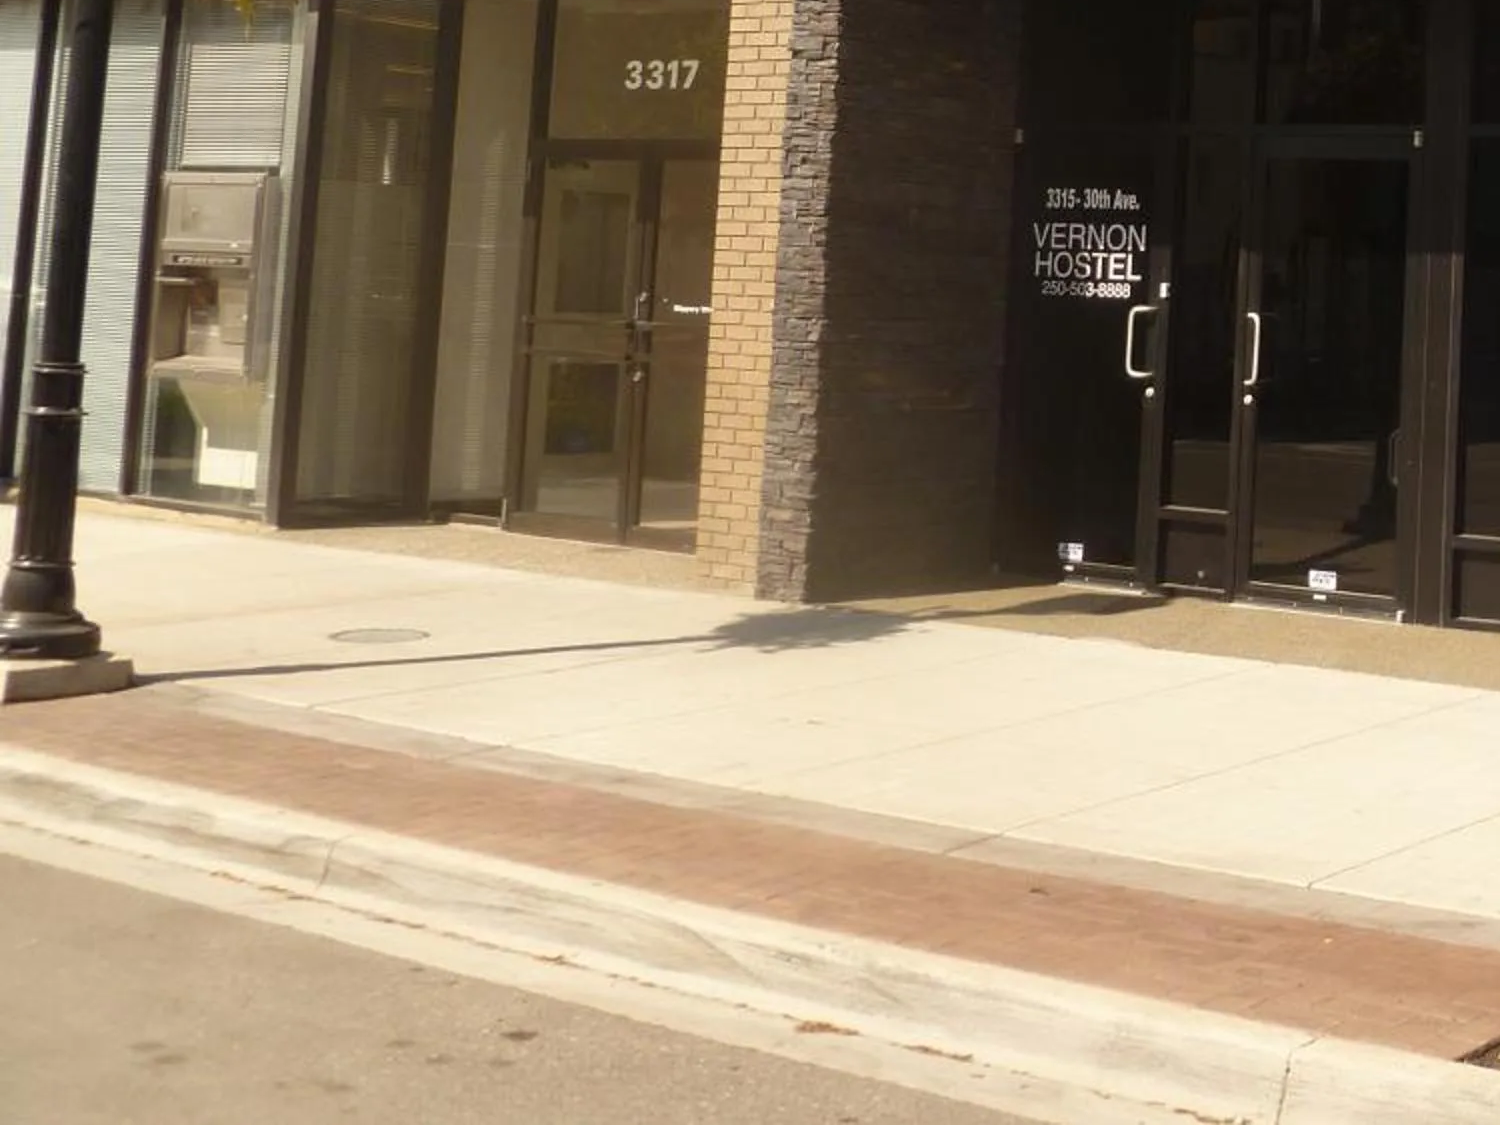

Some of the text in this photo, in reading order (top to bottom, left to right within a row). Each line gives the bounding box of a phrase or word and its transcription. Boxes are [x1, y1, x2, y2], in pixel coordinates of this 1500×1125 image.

[624, 58, 700, 91] 3317
[1084, 188, 1111, 209] 30th
[1114, 189, 1141, 211] Ave.
[1033, 222, 1147, 252] VERNON
[1034, 252, 1142, 281] HOSTEL
